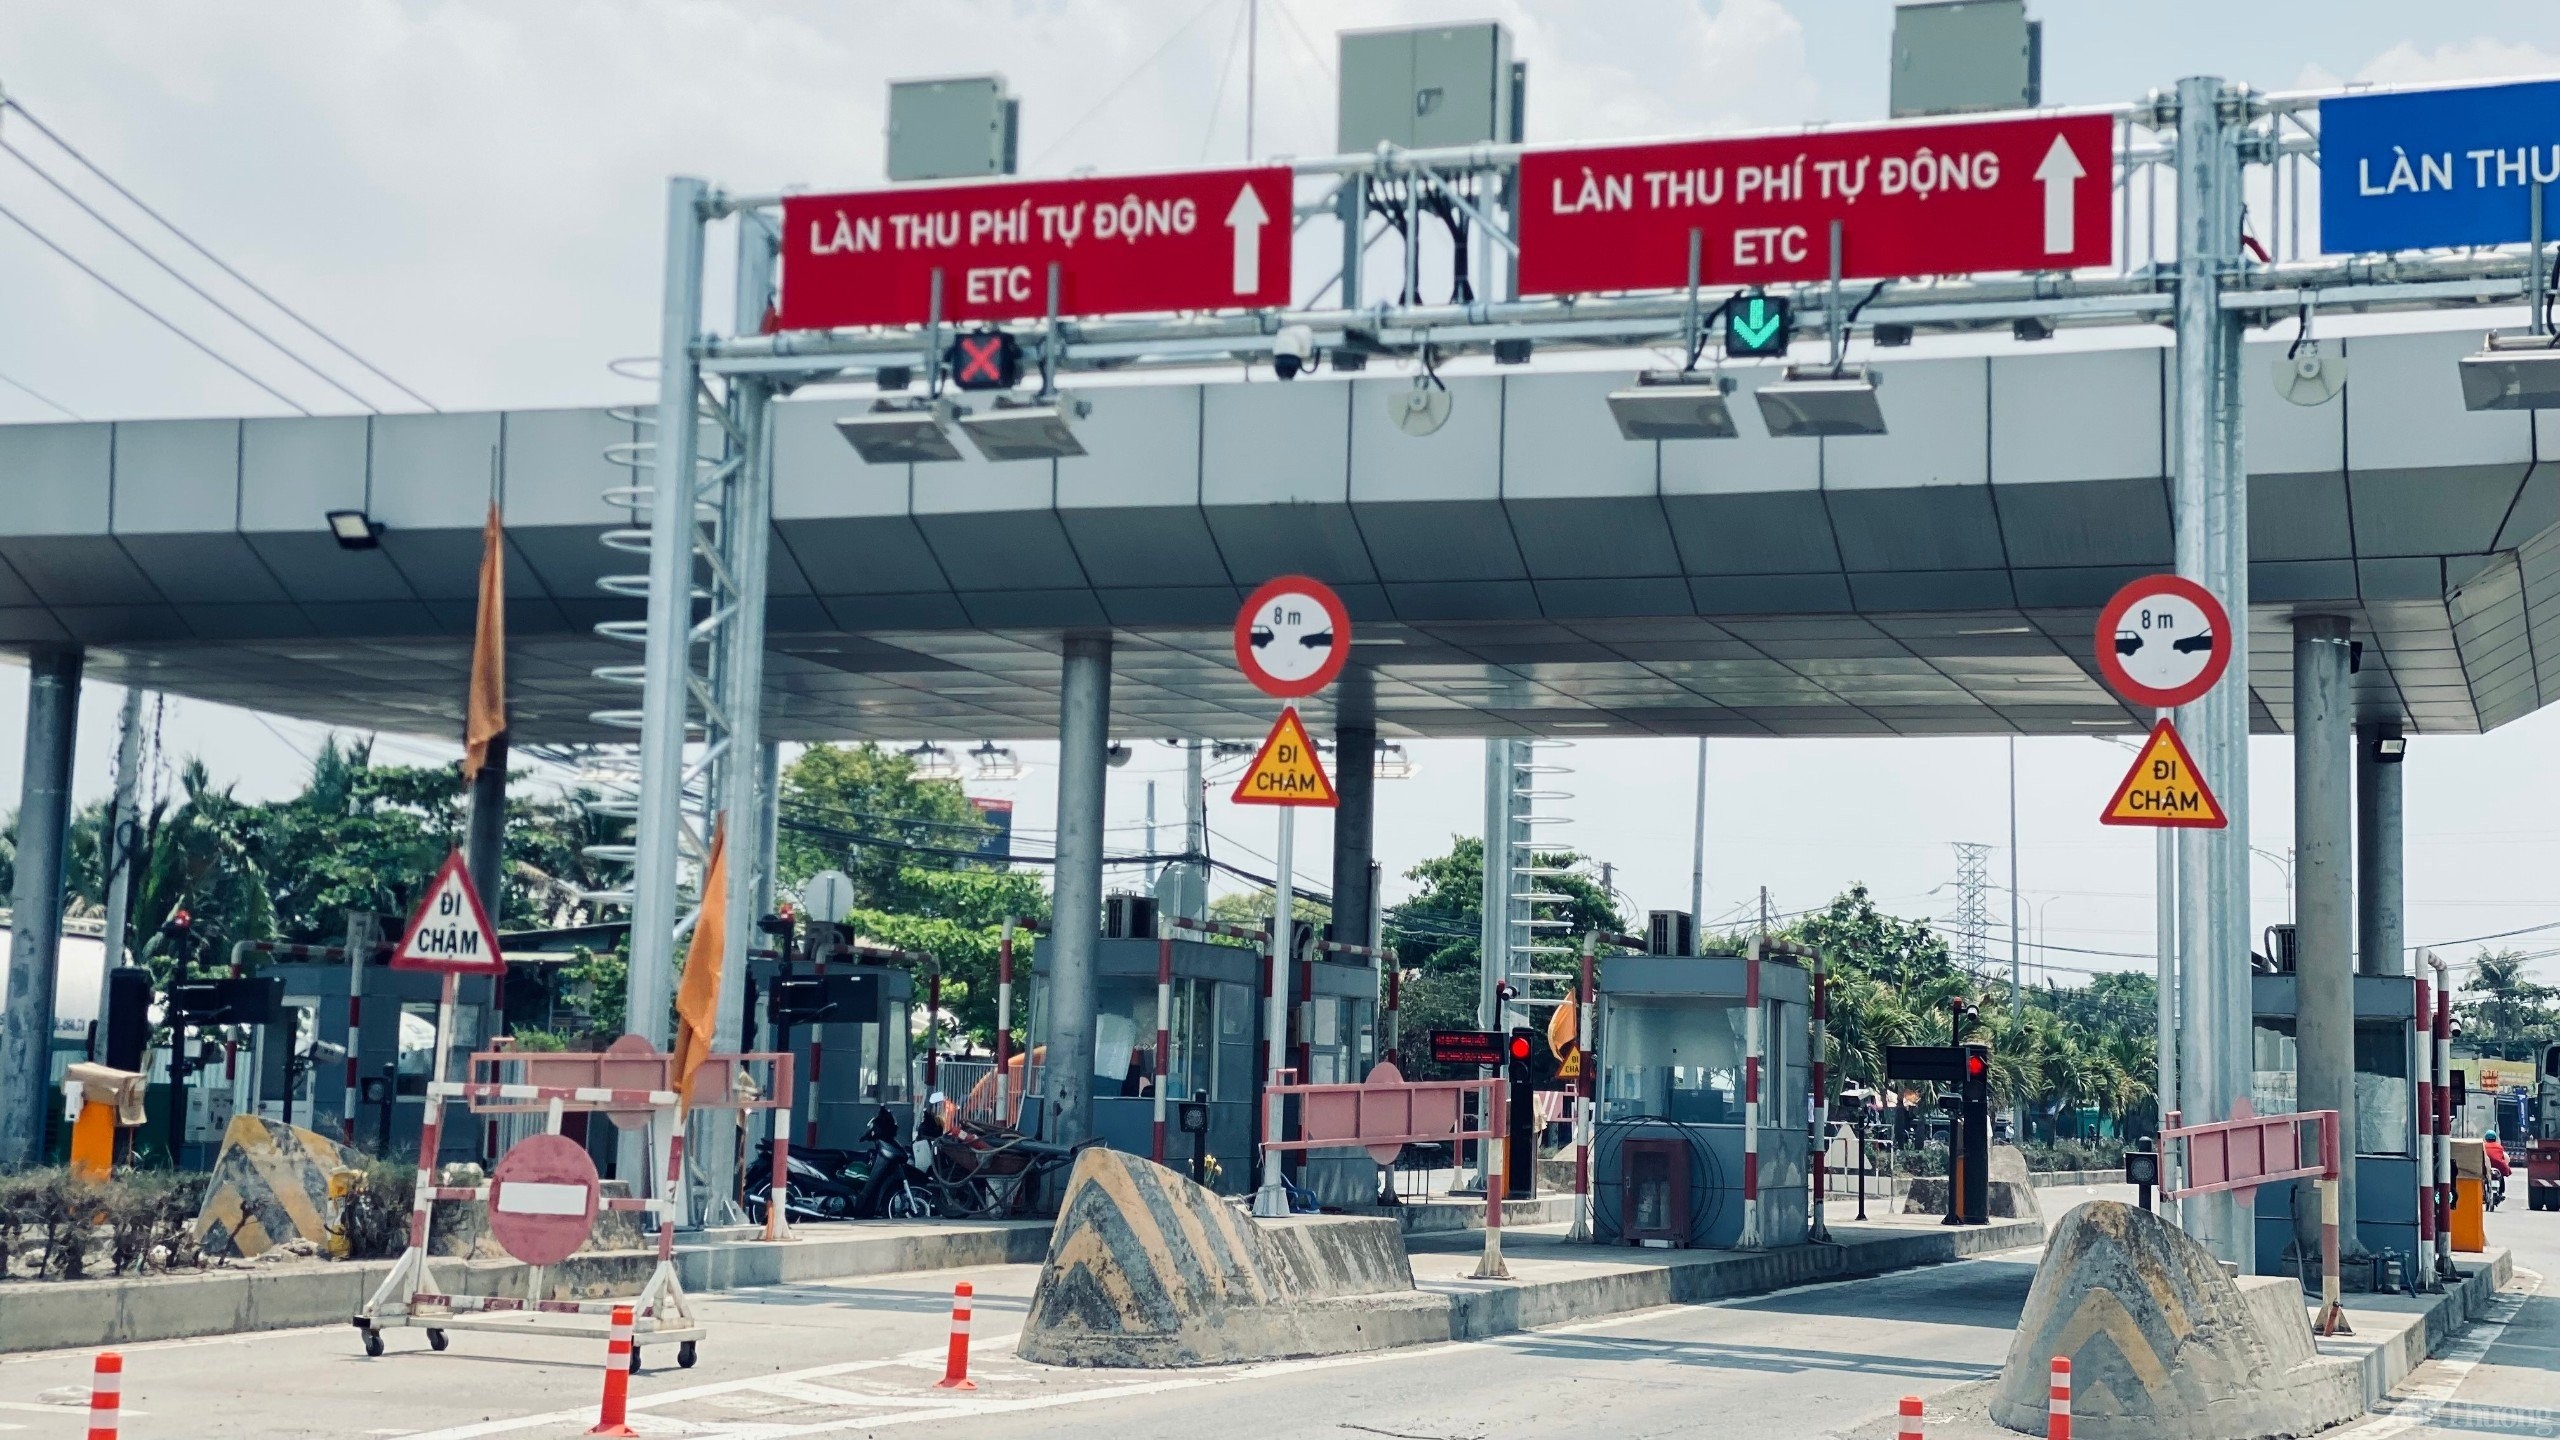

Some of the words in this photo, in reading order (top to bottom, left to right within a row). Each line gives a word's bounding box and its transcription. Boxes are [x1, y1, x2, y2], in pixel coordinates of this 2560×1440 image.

[1552, 166, 1633, 214] LÀN
[1644, 168, 1723, 208] THU
[1736, 154, 1805, 203] PHÍ
[1814, 155, 1870, 205] TỰ
[1879, 147, 2000, 200] ĐỘNG
[2359, 145, 2452, 196] LÀN
[2467, 145, 2560, 188] THU
[810, 210, 881, 255] LÀN
[889, 211, 960, 249] THU
[970, 200, 1031, 245] PHÍ
[1037, 201, 1086, 248] TỰ
[1092, 194, 1197, 244] ĐỘNG
[1733, 226, 1808, 266] ETC
[967, 266, 1031, 304] ETC
[1278, 745, 1298, 764] ĐI
[2153, 760, 2176, 780] ĐI
[1256, 769, 1315, 796] CHẬM
[2129, 786, 2199, 816] CHẬM
[440, 892, 461, 917] ĐI
[418, 922, 478, 959] CHẬM
